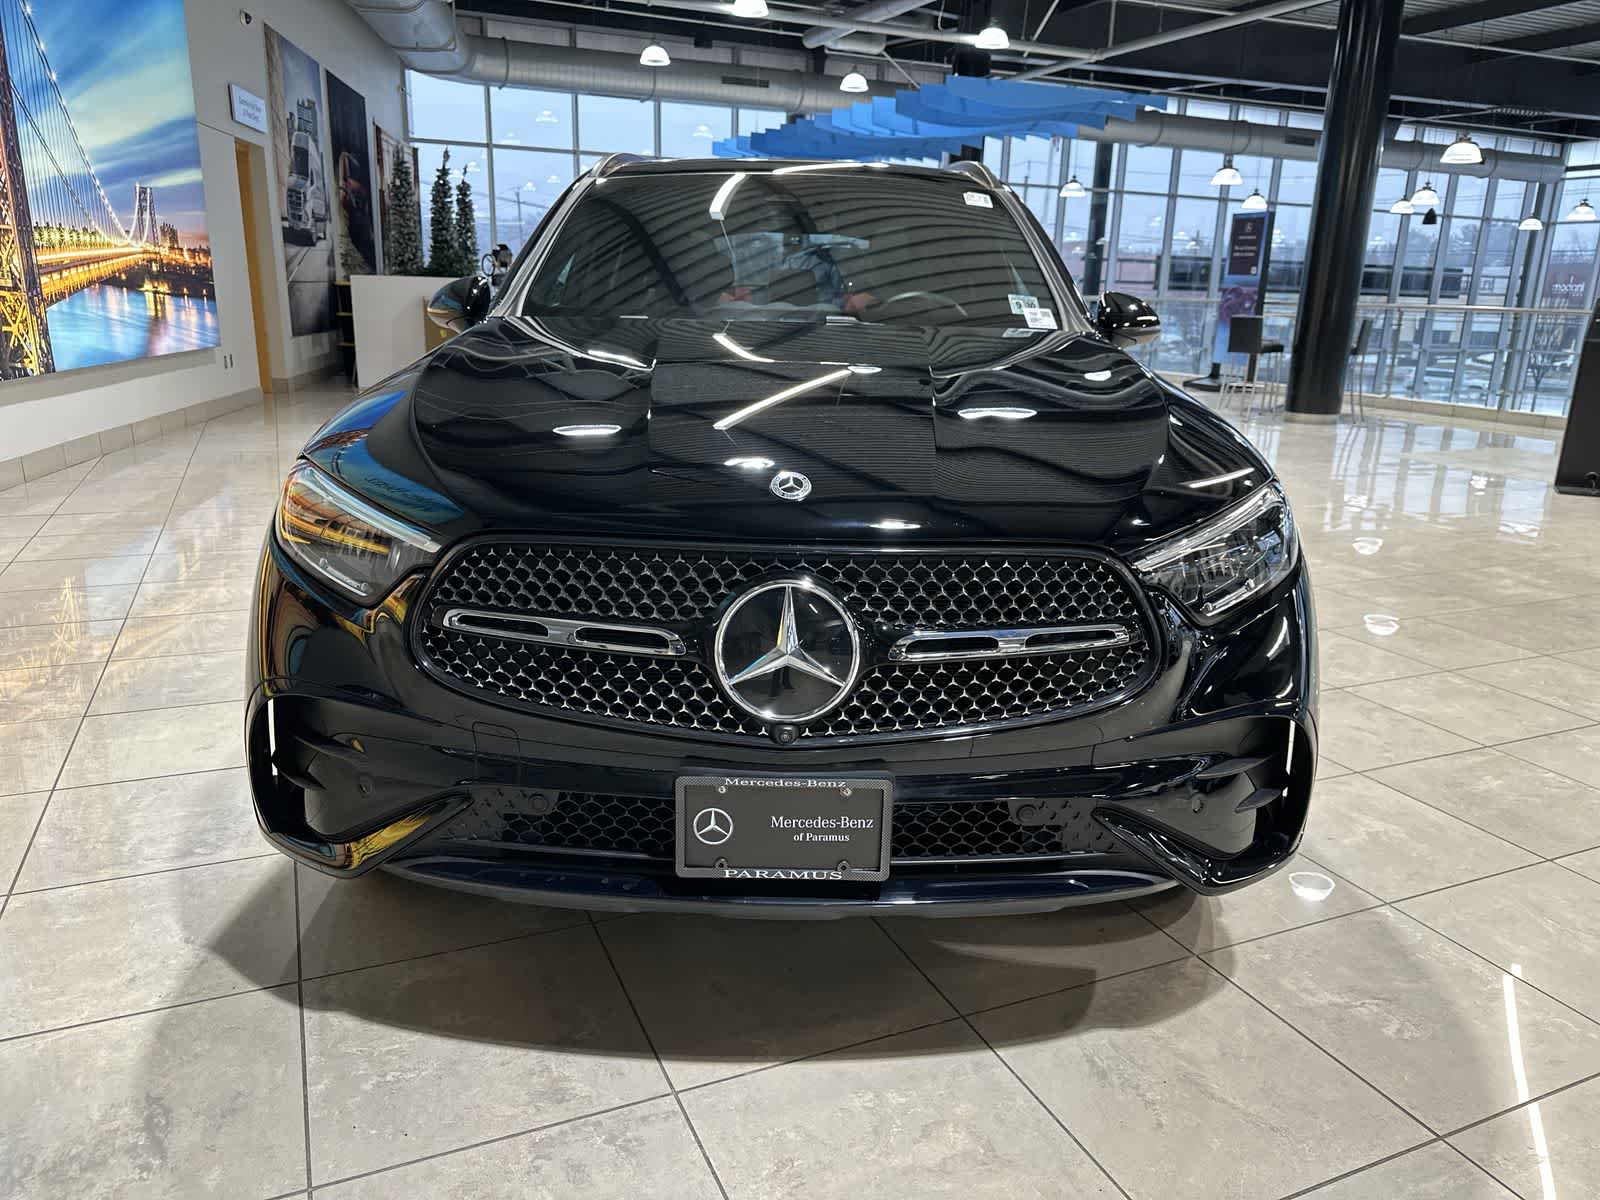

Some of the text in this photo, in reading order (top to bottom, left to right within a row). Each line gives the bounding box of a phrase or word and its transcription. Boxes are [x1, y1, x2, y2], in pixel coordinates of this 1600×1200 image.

[725, 778, 847, 788] Mercedes-Benz
[770, 815, 874, 829] Mercedes-Benz
[793, 832, 850, 842] of Paramus
[724, 869, 843, 880] PARAMUS
